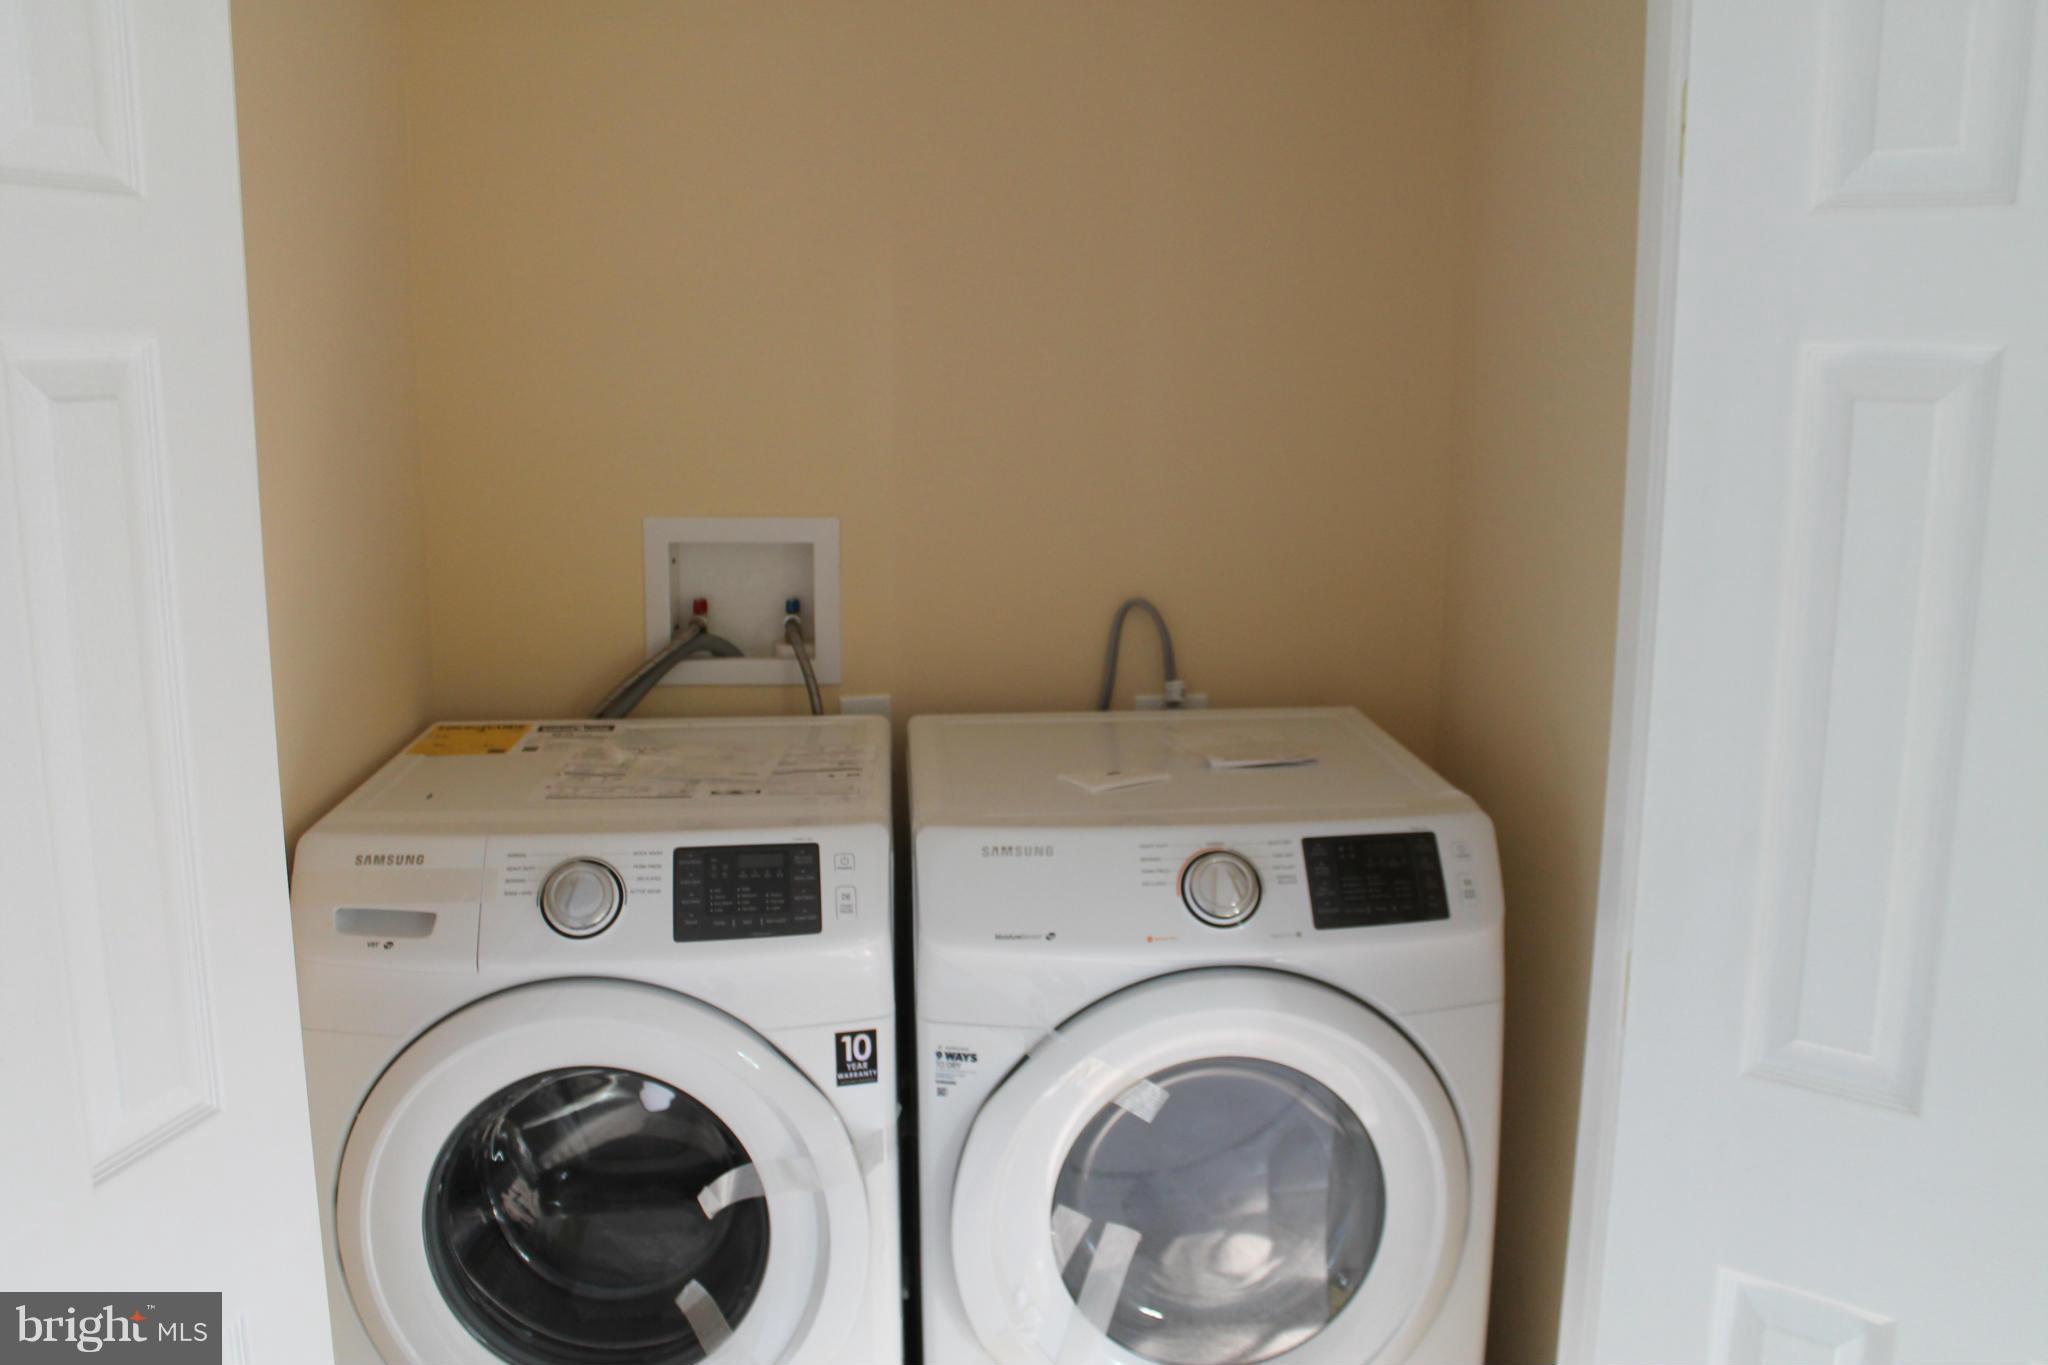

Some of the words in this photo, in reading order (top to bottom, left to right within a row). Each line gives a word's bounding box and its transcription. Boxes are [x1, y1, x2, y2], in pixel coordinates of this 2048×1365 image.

[981, 845, 1054, 857] SAMSUNG
[354, 854, 425, 866] SAMSUNG
[841, 1033, 872, 1062] 10
[945, 1052, 978, 1063] WAYS
[846, 1061, 868, 1071] YEAR
[837, 1069, 877, 1080] WARRANTY
